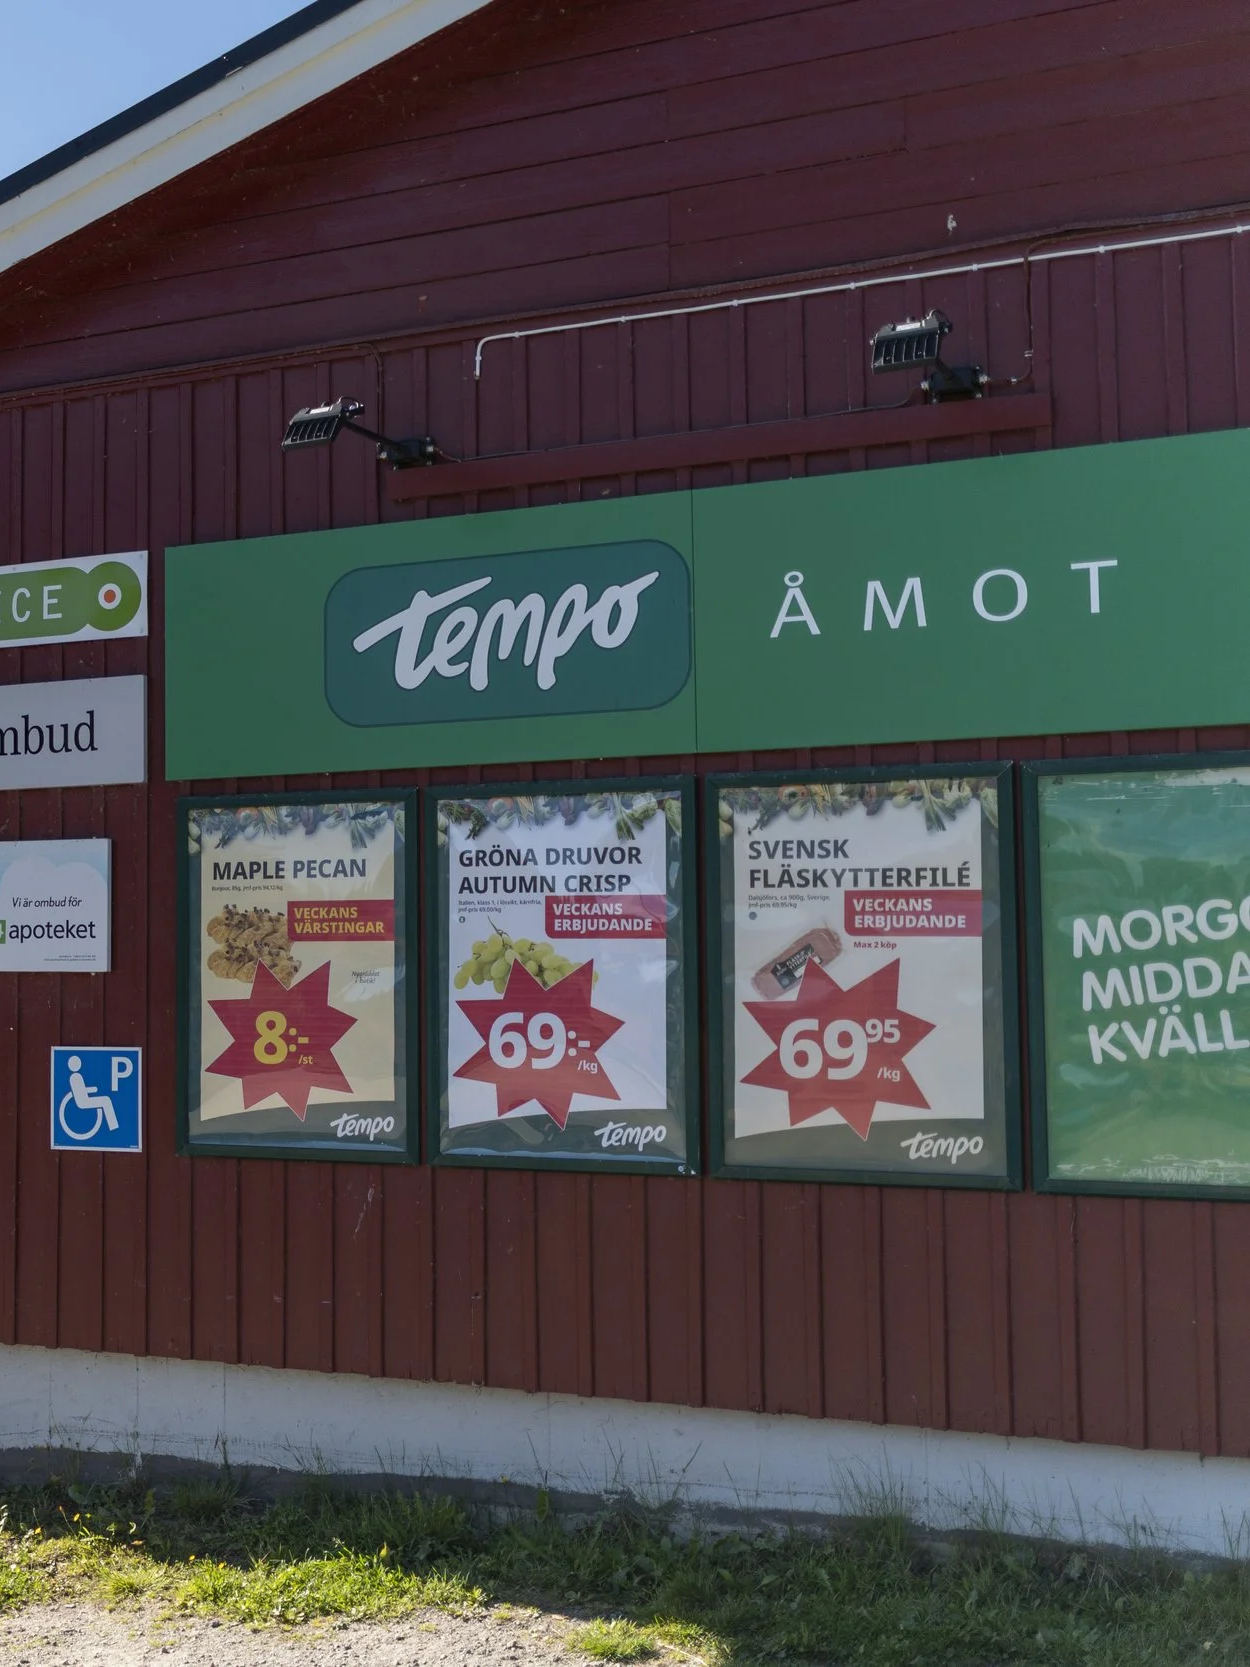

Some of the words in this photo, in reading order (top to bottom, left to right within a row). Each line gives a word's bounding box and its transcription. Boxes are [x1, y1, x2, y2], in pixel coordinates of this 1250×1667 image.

[770, 558, 1120, 639] ÅMOT
[458, 844, 539, 868] GRÖNA
[545, 846, 643, 866] DRUVOR
[748, 838, 851, 861] SVENSK
[212, 860, 286, 881] MAPLE
[292, 858, 367, 879] PECAN
[749, 860, 972, 890] FLÄSKYTTERFILÉ
[458, 874, 556, 895] AUTUMN
[563, 874, 632, 893] CRISP
[12, 896, 22, 908] Vi
[22, 897, 32, 908] är
[34, 896, 67, 908] ombud
[67, 895, 83, 908] för
[552, 902, 623, 916] VECKANS
[852, 897, 933, 913] VECKANS
[293, 906, 358, 920] VECKANS
[8, 919, 97, 944] apoteket
[293, 919, 385, 934] VÄRSTINGAR
[553, 918, 653, 935] ERBJUDANDE
[854, 914, 967, 932] ERBJUDANDE
[1072, 895, 1250, 959] MORG
[853, 940, 872, 949] Max
[873, 940, 880, 949] 2
[881, 940, 898, 951] köp
[298, 1055, 314, 1065] /st
[577, 1060, 598, 1074] /kg
[111, 1056, 134, 1092] P
[877, 1066, 901, 1082] /kg
